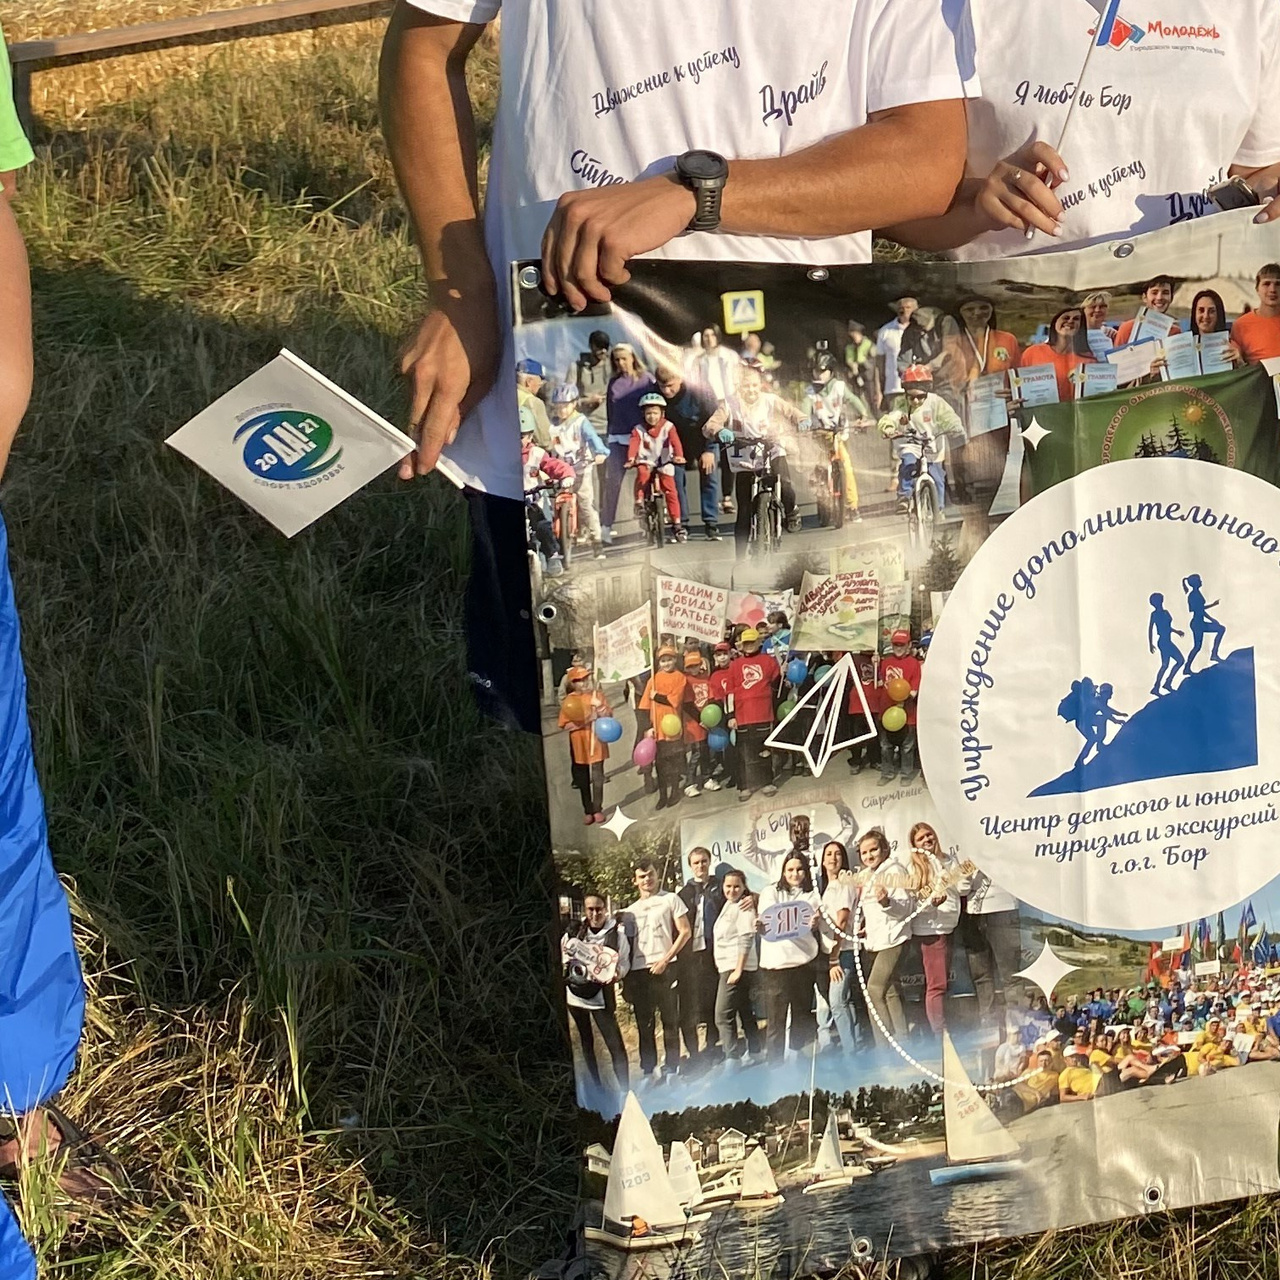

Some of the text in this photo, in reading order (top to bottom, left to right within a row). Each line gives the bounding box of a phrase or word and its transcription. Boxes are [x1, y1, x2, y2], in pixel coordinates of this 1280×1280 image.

[592, 46, 741, 118] Движение к успеху
[759, 60, 829, 127] Драйв
[1013, 80, 1030, 106] Я
[1100, 85, 1132, 116] Бор
[570, 149, 632, 187] Стре
[1088, 183, 1098, 198] к
[1023, 373, 1055, 384] ГРАМОТА
[298, 418, 320, 435] 21
[1102, 405, 1129, 464] ОРОДСКОГО
[254, 452, 278, 472] 20
[1012, 500, 1280, 600] дополнительного
[661, 580, 723, 602] НЕ ДАДИМ В
[673, 594, 715, 611] ОБИДУ
[980, 812, 1063, 840] Центр
[1067, 794, 1173, 832] детского
[1175, 793, 1190, 809] и
[1034, 803, 1279, 863] туризма и экскурсий
[1109, 845, 1210, 875] г.о.г. Бор
[621, 1172, 651, 1189] 1203
